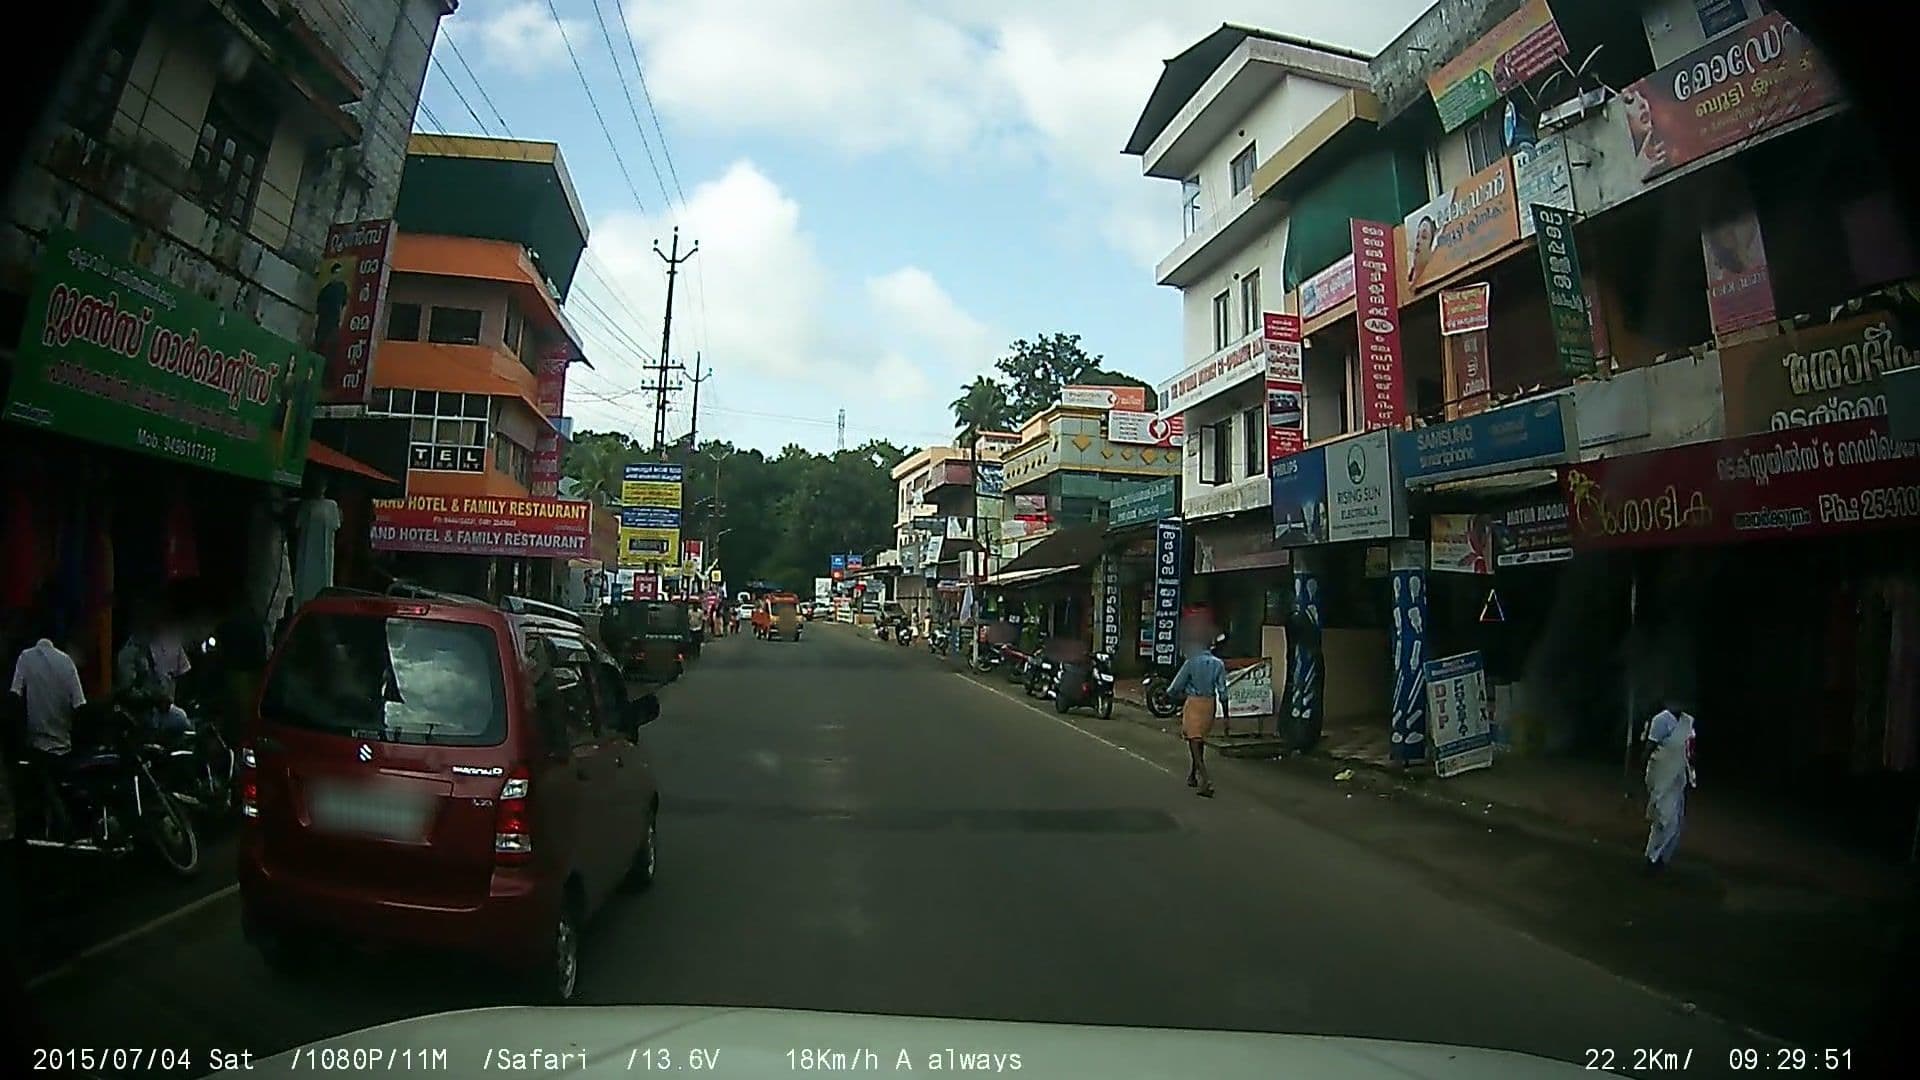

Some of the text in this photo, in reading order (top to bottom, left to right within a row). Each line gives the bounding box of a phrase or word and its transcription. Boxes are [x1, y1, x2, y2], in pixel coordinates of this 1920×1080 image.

[1416, 423, 1473, 451] SAMSUNG
[415, 448, 478, 462] TEL
[1823, 442, 1834, 467] &
[1364, 486, 1381, 502] SUN
[408, 496, 447, 512] HOTEL
[451, 498, 459, 513] &
[464, 498, 506, 516] FAMILY
[509, 501, 587, 520] RESTAURANT
[400, 527, 440, 542] HOTEL
[444, 530, 453, 543] &
[457, 530, 501, 546] FAMILY
[505, 532, 586, 549] RESTAURANT
[1435, 684, 1448, 729] DTP
